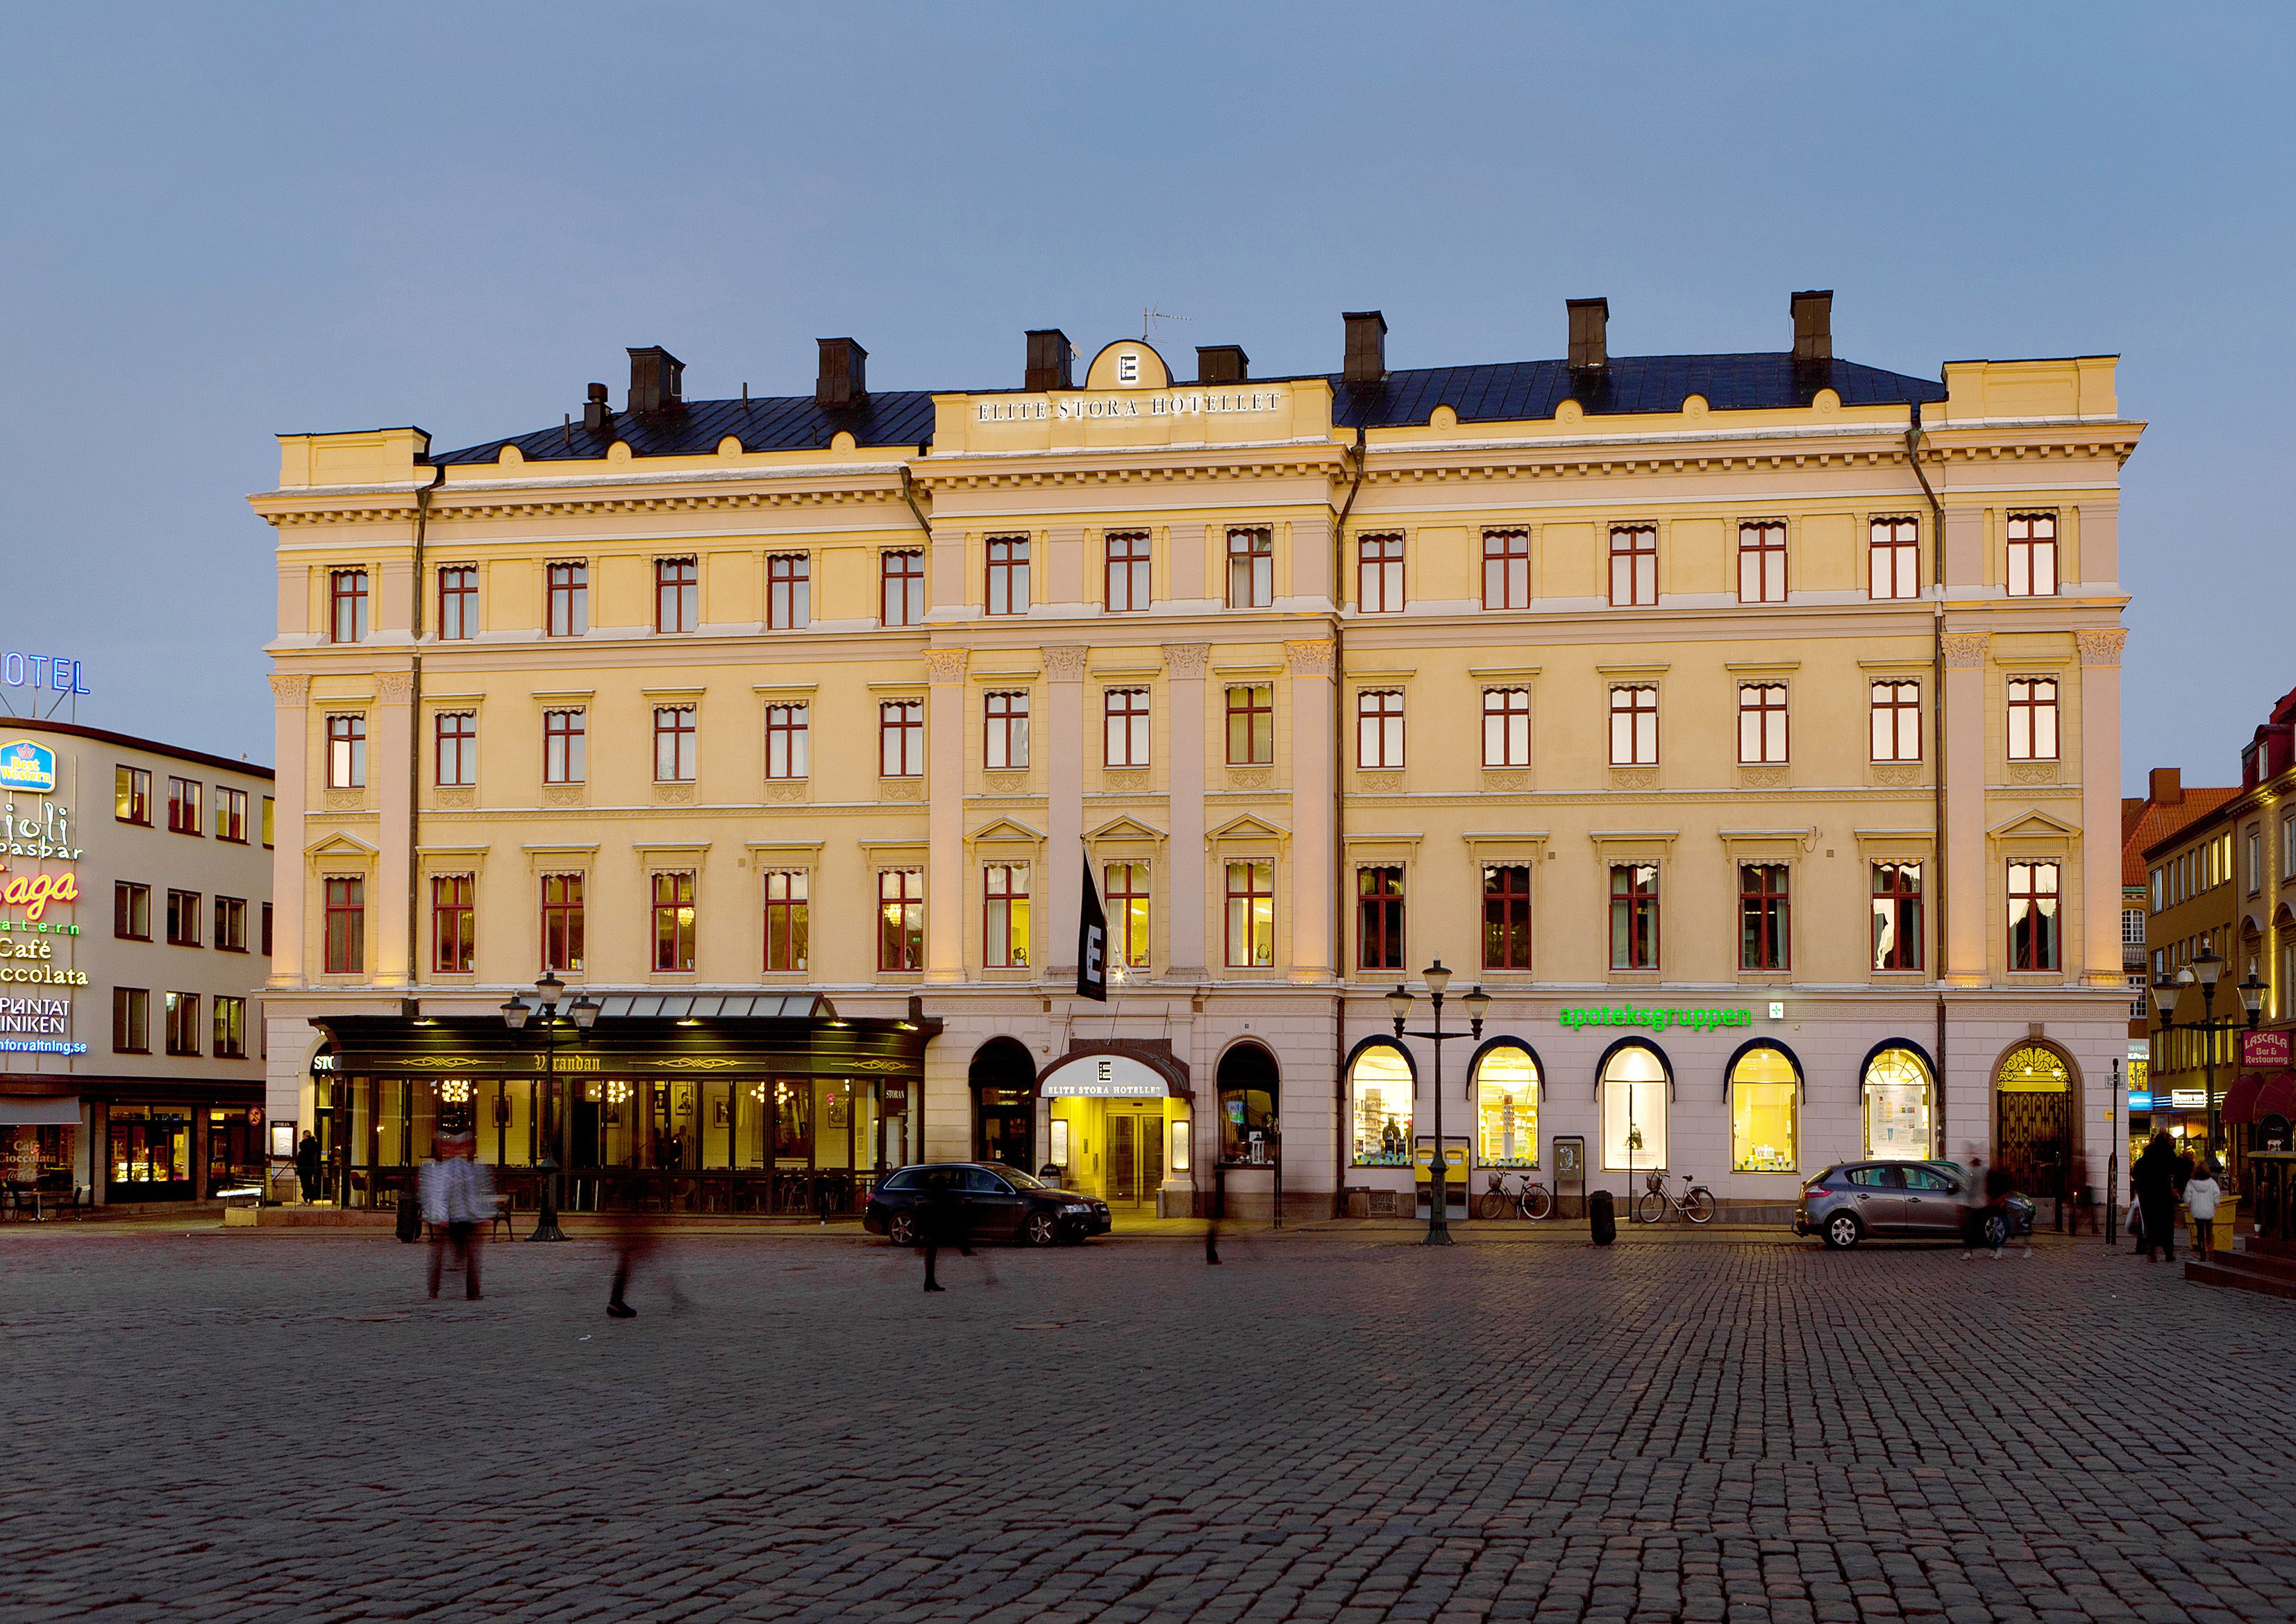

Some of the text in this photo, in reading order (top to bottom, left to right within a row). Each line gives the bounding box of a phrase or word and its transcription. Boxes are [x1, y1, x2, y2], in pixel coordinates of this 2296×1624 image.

[1120, 355, 1137, 381] E
[978, 393, 1280, 421] ELITE STORA HOTELLET
[0, 652, 90, 694] OTEL
[11, 756, 40, 771] Best
[1, 765, 51, 785] Western
[0, 801, 68, 846] ioli
[0, 864, 79, 920] aga
[0, 937, 52, 960] Café
[1087, 924, 1101, 983] E
[0, 964, 89, 986] ccolata
[0, 1015, 65, 1034] INIKEN
[1559, 1003, 1752, 1031] apoteksgruppen
[2245, 1055, 2288, 1064] Restaurang
[2256, 1047, 2277, 1055] Bar &
[534, 1055, 601, 1071] Vrandan
[1098, 1061, 1111, 1081] E
[886, 1090, 905, 1098] STORAN
[1048, 1086, 1162, 1094] ELITE STORA HOTELLET
[14, 1140, 40, 1151] Café
